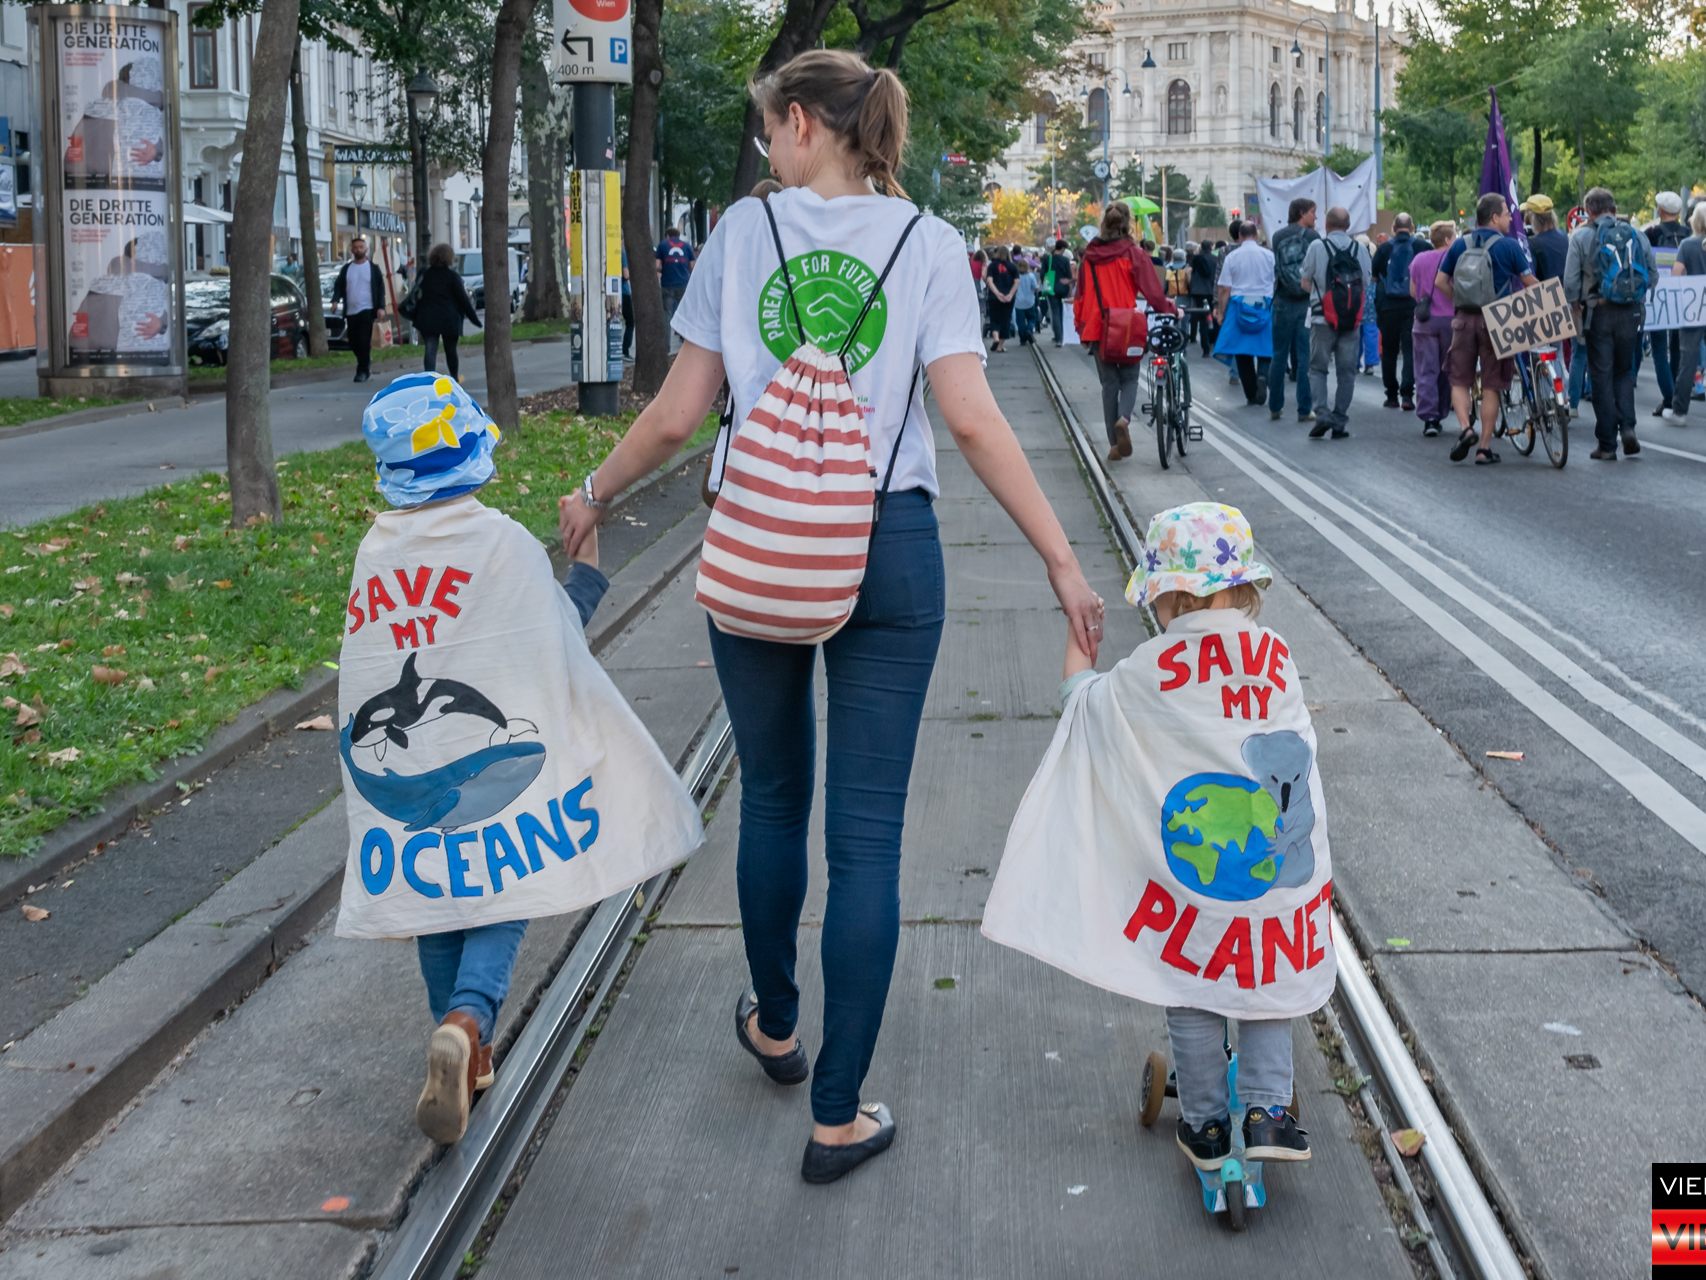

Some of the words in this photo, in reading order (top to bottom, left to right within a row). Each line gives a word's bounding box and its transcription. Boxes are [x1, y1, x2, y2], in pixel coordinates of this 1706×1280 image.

[64, 22, 89, 35] DIE
[94, 23, 147, 38] DRITTE
[64, 36, 160, 53] GENERATION
[558, 63, 579, 76] 400
[582, 65, 595, 75] m
[70, 199, 94, 211] DIE
[99, 199, 152, 213] DRITTE
[70, 212, 165, 227] GENERATION
[801, 254, 831, 277] FOR
[1489, 281, 1562, 327] DON'T
[348, 565, 473, 635] SAVE
[389, 614, 439, 650] MY
[1157, 631, 1289, 693] SAVE
[1221, 685, 1273, 720] MY
[360, 776, 601, 899] OCEANS
